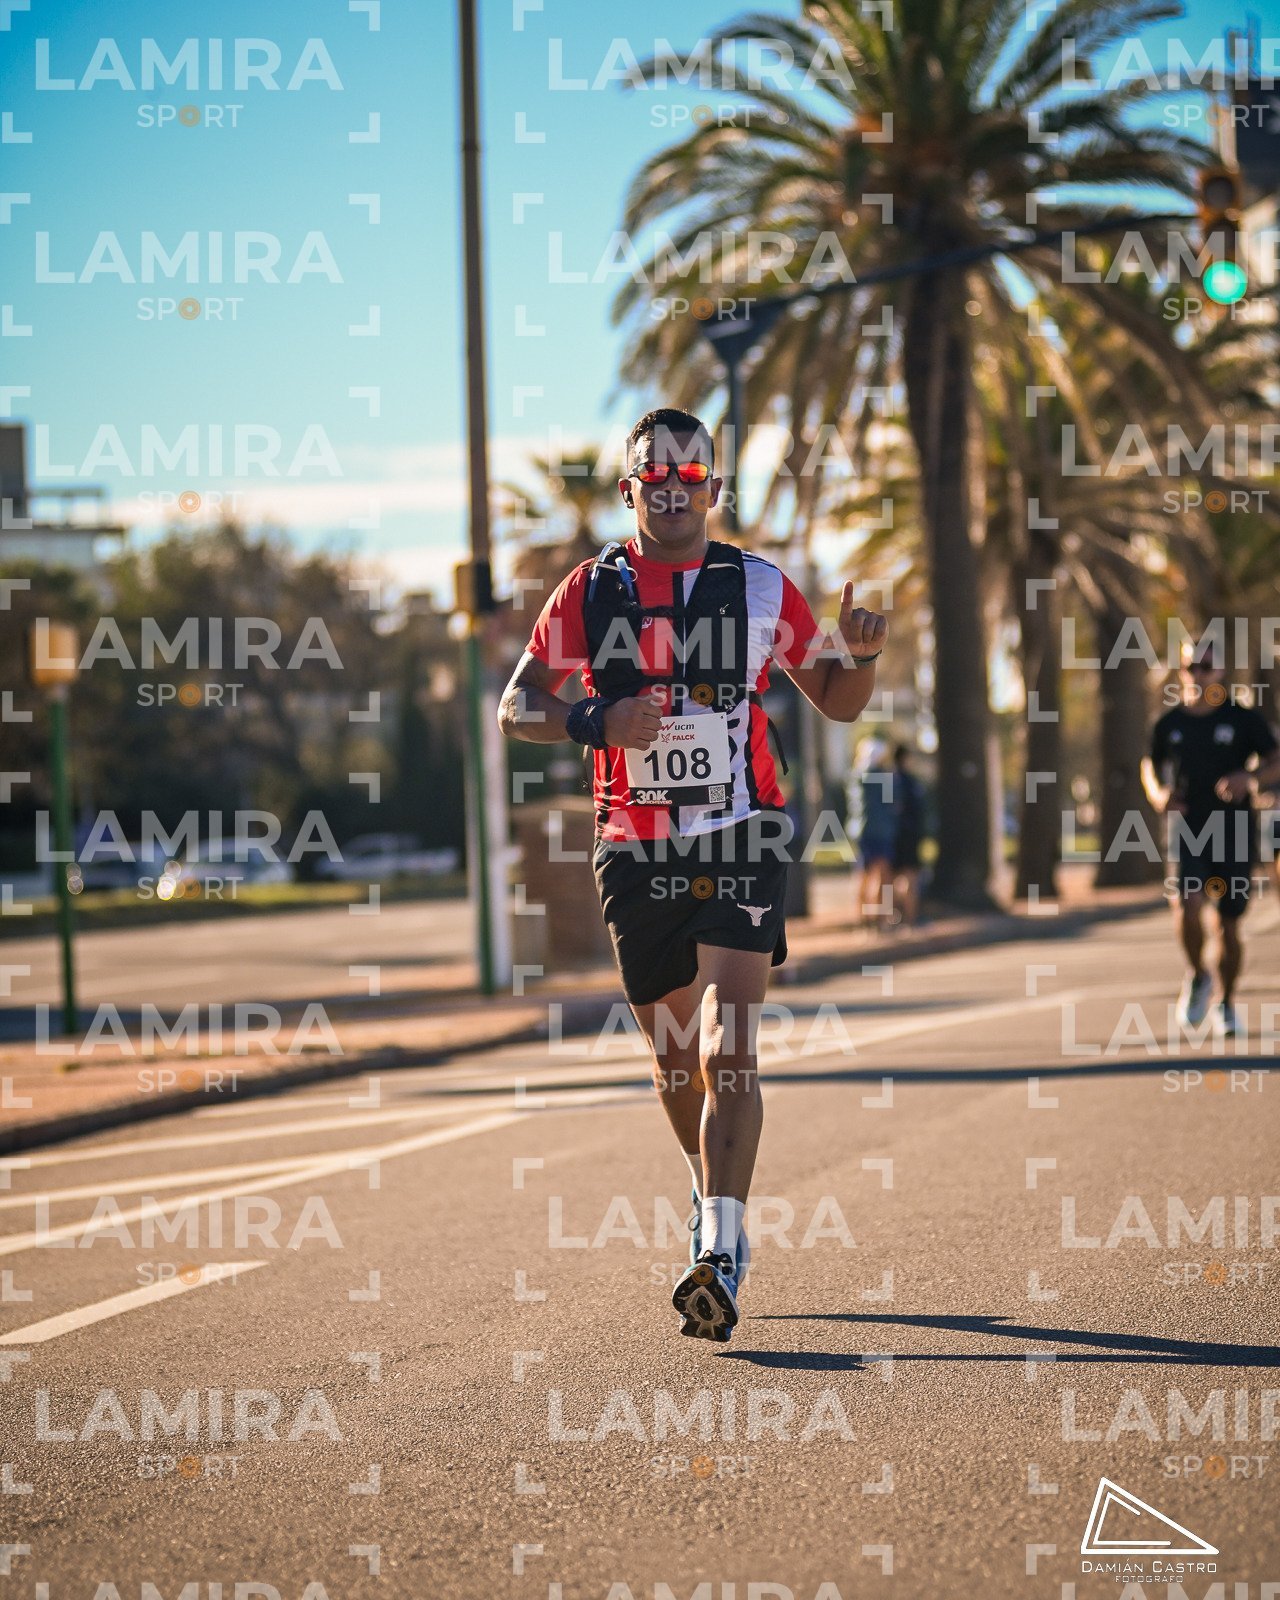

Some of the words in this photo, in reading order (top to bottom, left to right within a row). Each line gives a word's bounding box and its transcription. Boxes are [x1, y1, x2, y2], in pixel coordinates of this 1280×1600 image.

[674, 723, 695, 731] ucm
[644, 747, 712, 782] 108
[636, 790, 669, 805] 30K
